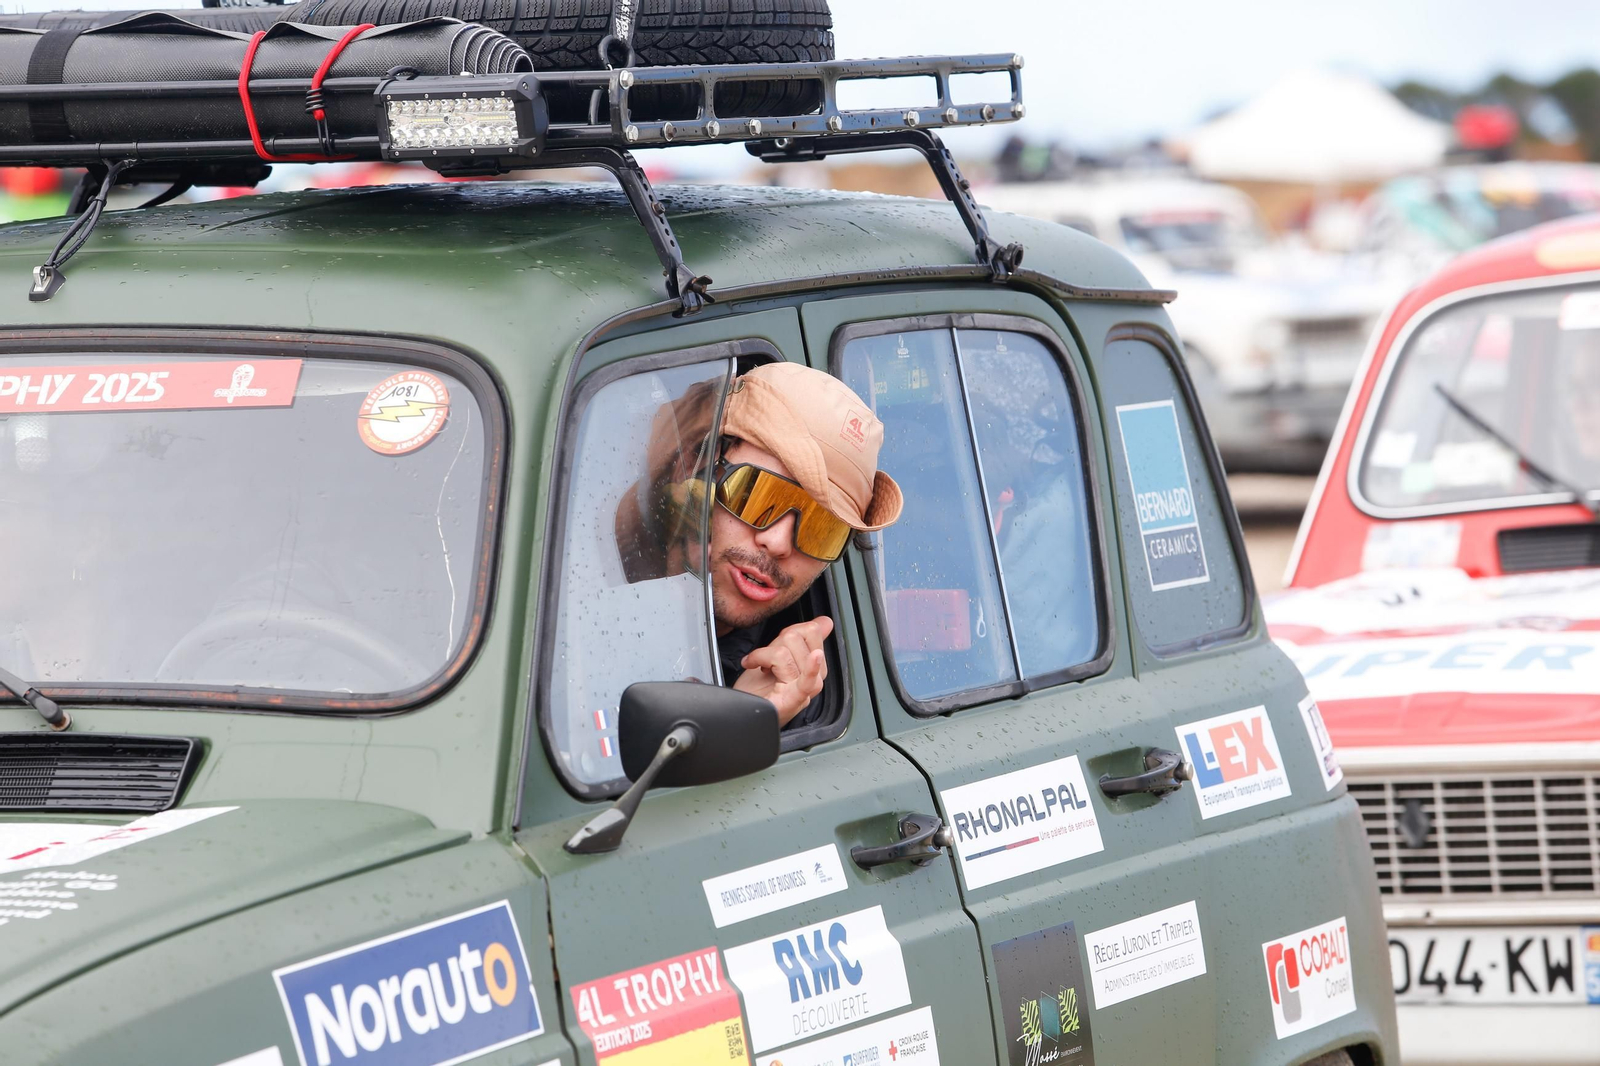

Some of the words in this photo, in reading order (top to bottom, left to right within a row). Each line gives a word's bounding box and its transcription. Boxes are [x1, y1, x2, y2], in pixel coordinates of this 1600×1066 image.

[0, 373, 77, 405] PHY
[82, 371, 170, 404] 2025
[379, 384, 420, 402] 1081
[849, 417, 865, 437] 4L
[1136, 486, 1192, 523] BERNARD
[1149, 533, 1198, 560] CERAMICS
[1234, 782, 1261, 797] Transports
[1261, 776, 1284, 791] Logistics
[953, 782, 1087, 843] RHONALPAL
[1038, 830, 1051, 841] Une
[1050, 825, 1068, 840] palette
[1067, 820, 1076, 833] de
[1075, 818, 1096, 832] services
[720, 886, 748, 908] RENNES
[745, 880, 771, 902] SCHOOL
[768, 877, 778, 895] OF
[776, 869, 807, 893] BUSINESS
[772, 922, 863, 1003] RMC
[1300, 925, 1348, 978] COBALT
[577, 986, 617, 1028] 4L
[613, 951, 721, 1018] TROPHY
[1324, 970, 1351, 999] Conseil
[304, 942, 517, 1066] Norauto
[793, 993, 869, 1036] DÉCOUVERTE
[631, 1020, 653, 1043] 2025
[898, 1030, 930, 1047] CROIX-ROUGE
[851, 1045, 881, 1066] SURFRIDER
[899, 1042, 927, 1058] FRANÇAISE
